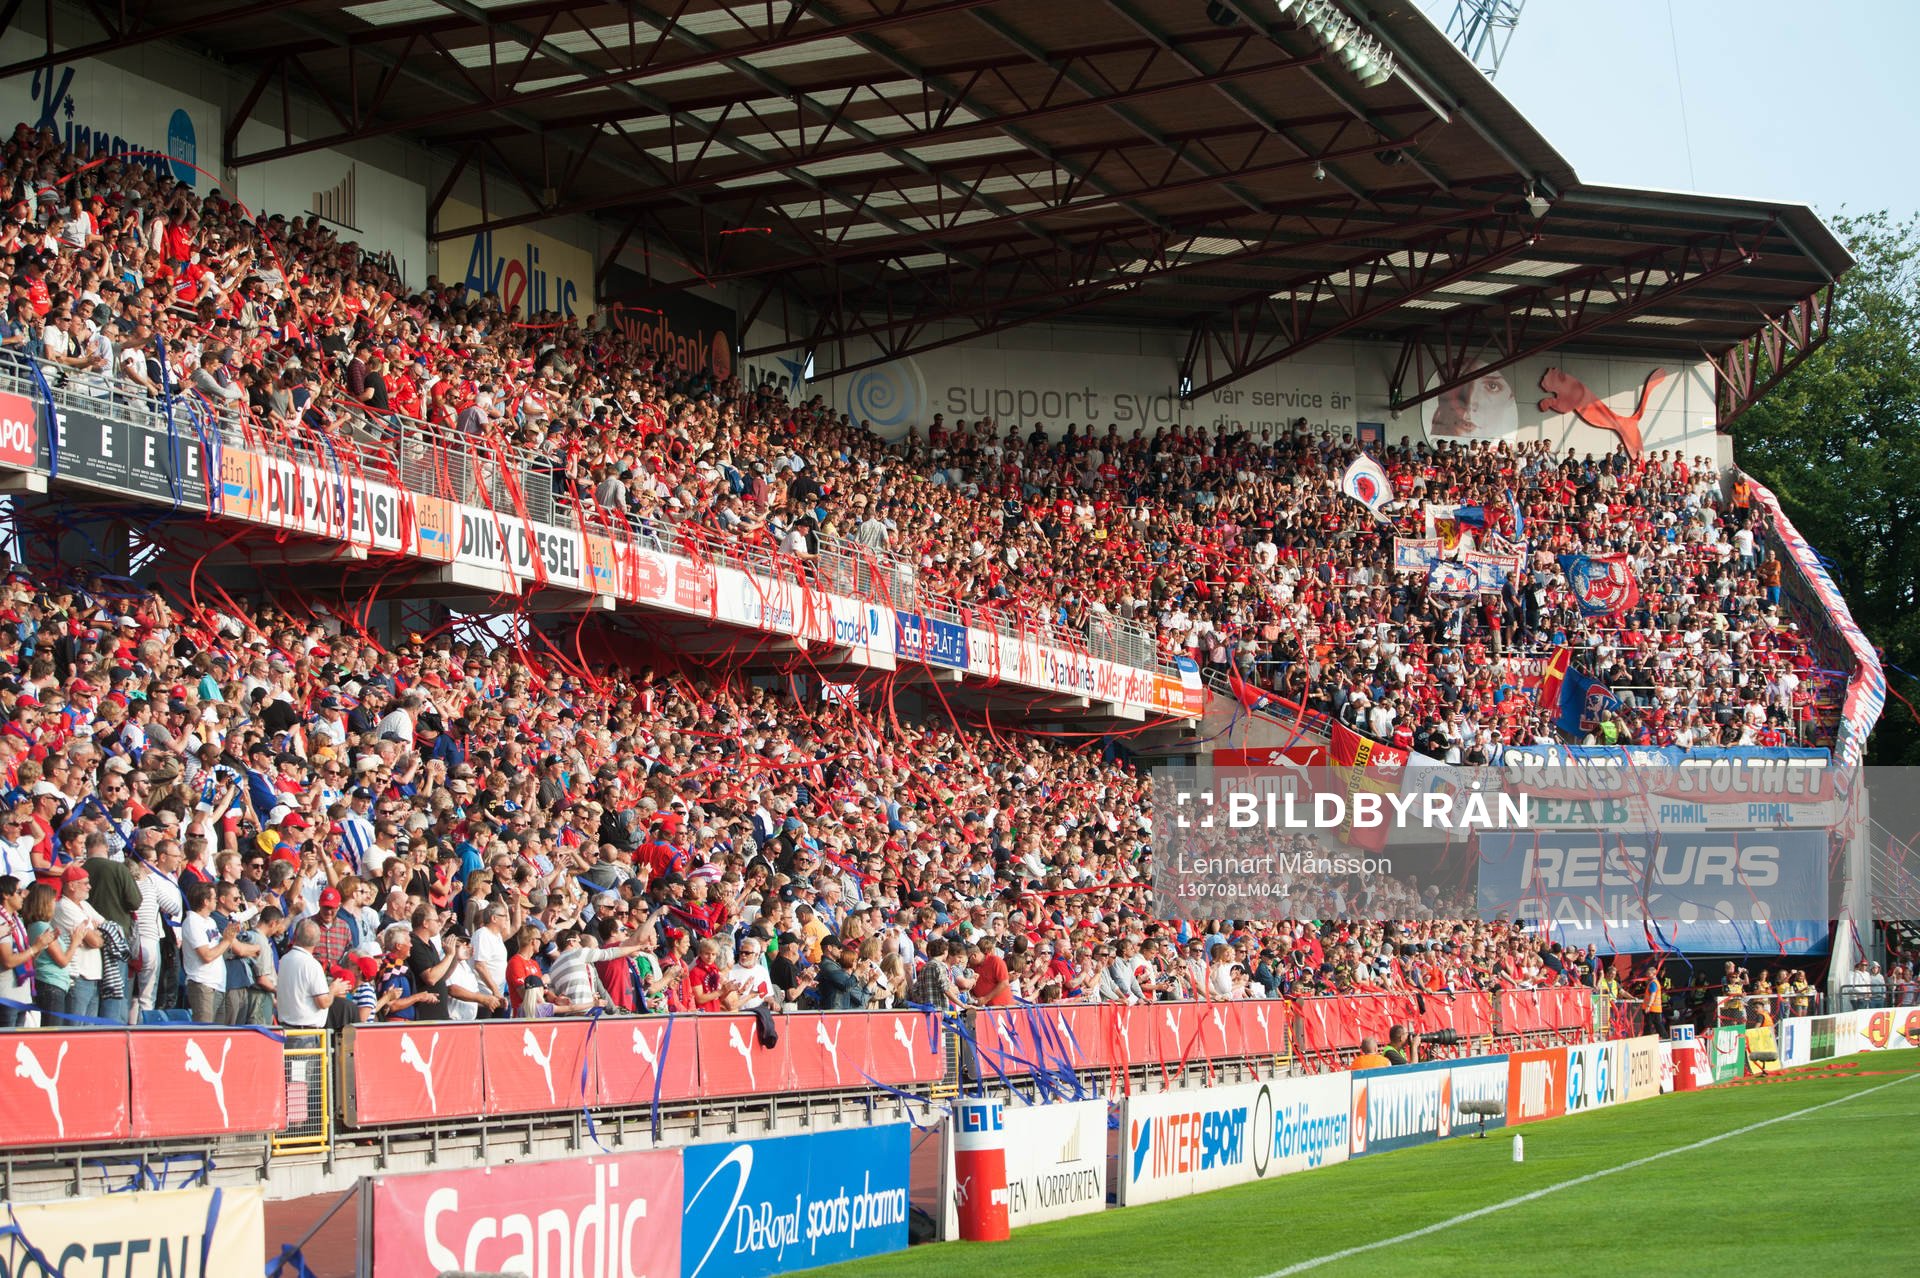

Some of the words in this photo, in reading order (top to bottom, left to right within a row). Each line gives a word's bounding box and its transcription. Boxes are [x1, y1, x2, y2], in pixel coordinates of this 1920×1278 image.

[947, 384, 1099, 428] support
[1113, 384, 1173, 431] syd
[1212, 384, 1244, 405] vår
[1252, 387, 1322, 410] service
[1331, 391, 1352, 410] är
[1504, 749, 1625, 791] SKÅNES
[1678, 757, 1827, 795] STOLTHET
[1520, 845, 1780, 890] RESURS
[1518, 895, 1665, 932] BANK
[1152, 1107, 1248, 1179] INTERSPORT
[1273, 1102, 1347, 1167] Rörläggaren
[1036, 1165, 1101, 1210] NORRPORTEN
[733, 1193, 802, 1263] DeRoyal
[806, 1186, 850, 1256] sports
[851, 1170, 906, 1249] pharma
